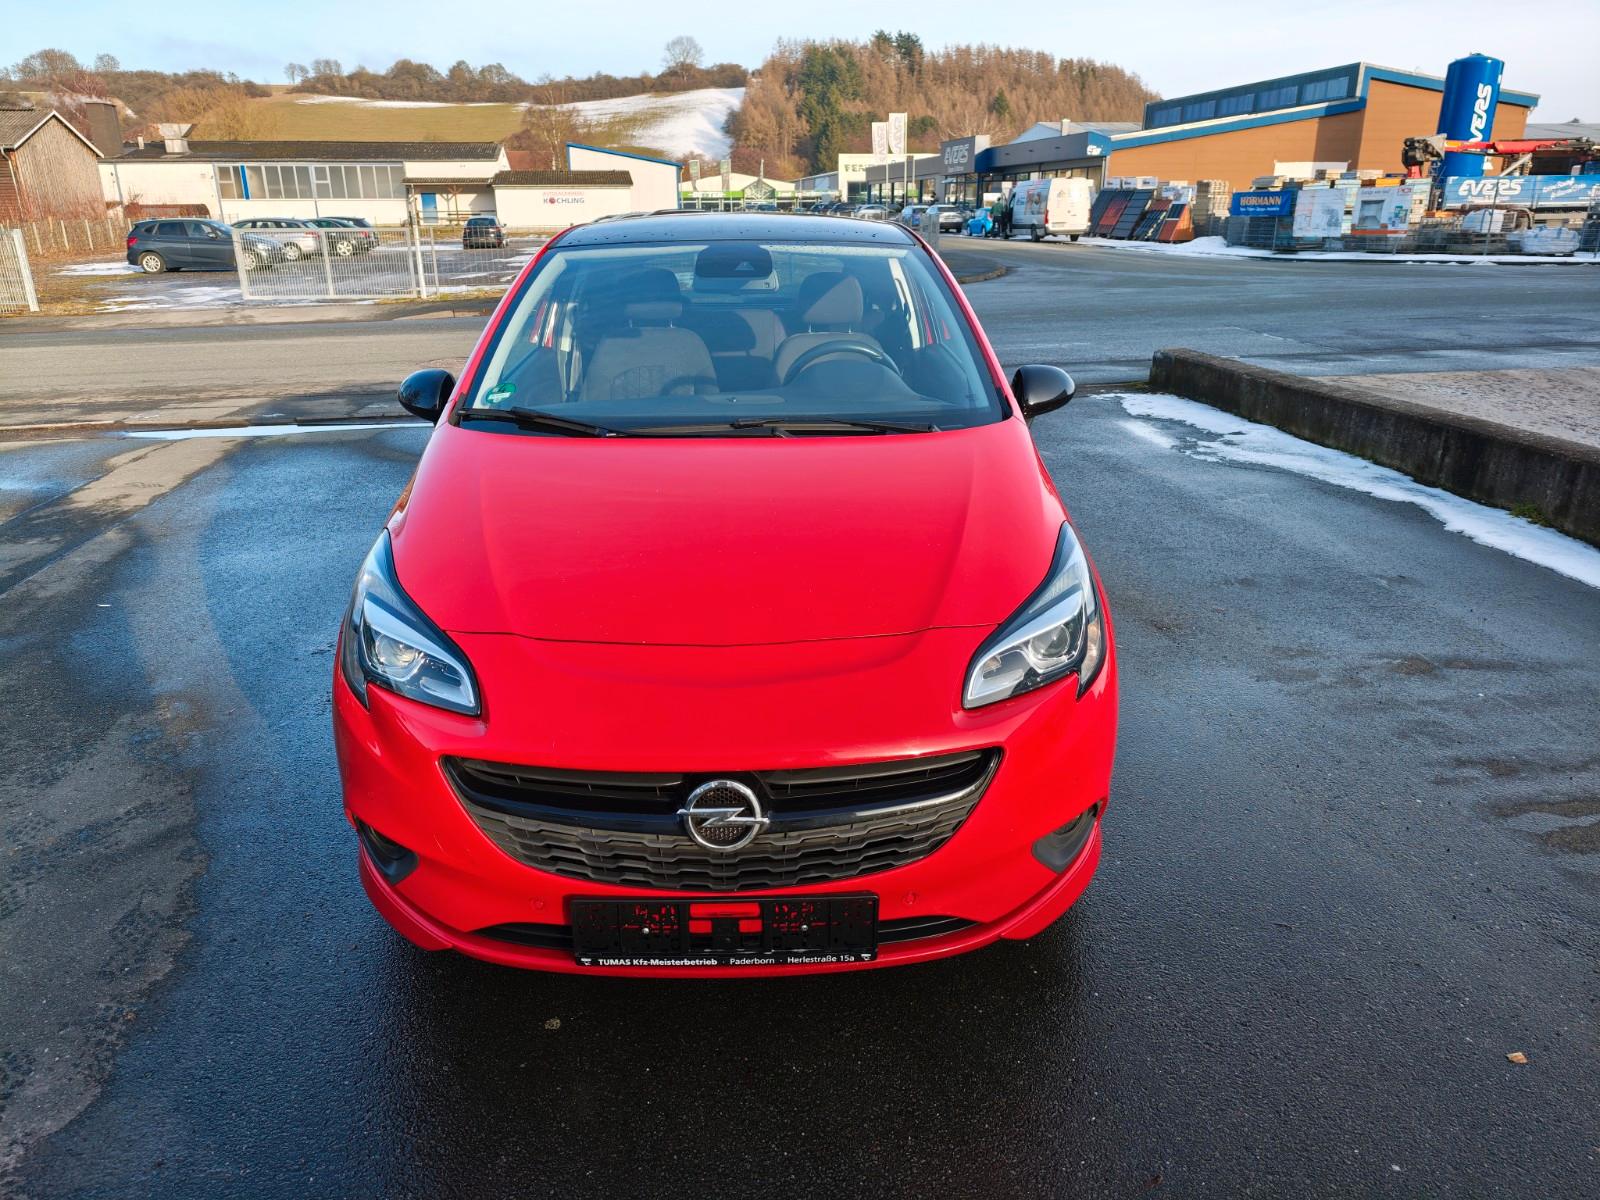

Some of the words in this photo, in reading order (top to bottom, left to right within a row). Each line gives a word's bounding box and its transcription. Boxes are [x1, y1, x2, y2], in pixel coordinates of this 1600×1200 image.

[1468, 82, 1493, 143] VERS
[1458, 179, 1526, 196] EVERS
[598, 958, 631, 966] TUMAS
[632, 957, 718, 966] Kfz-Meisterbetrieb
[730, 957, 775, 965] Paderborn
[840, 954, 855, 962] 15a
